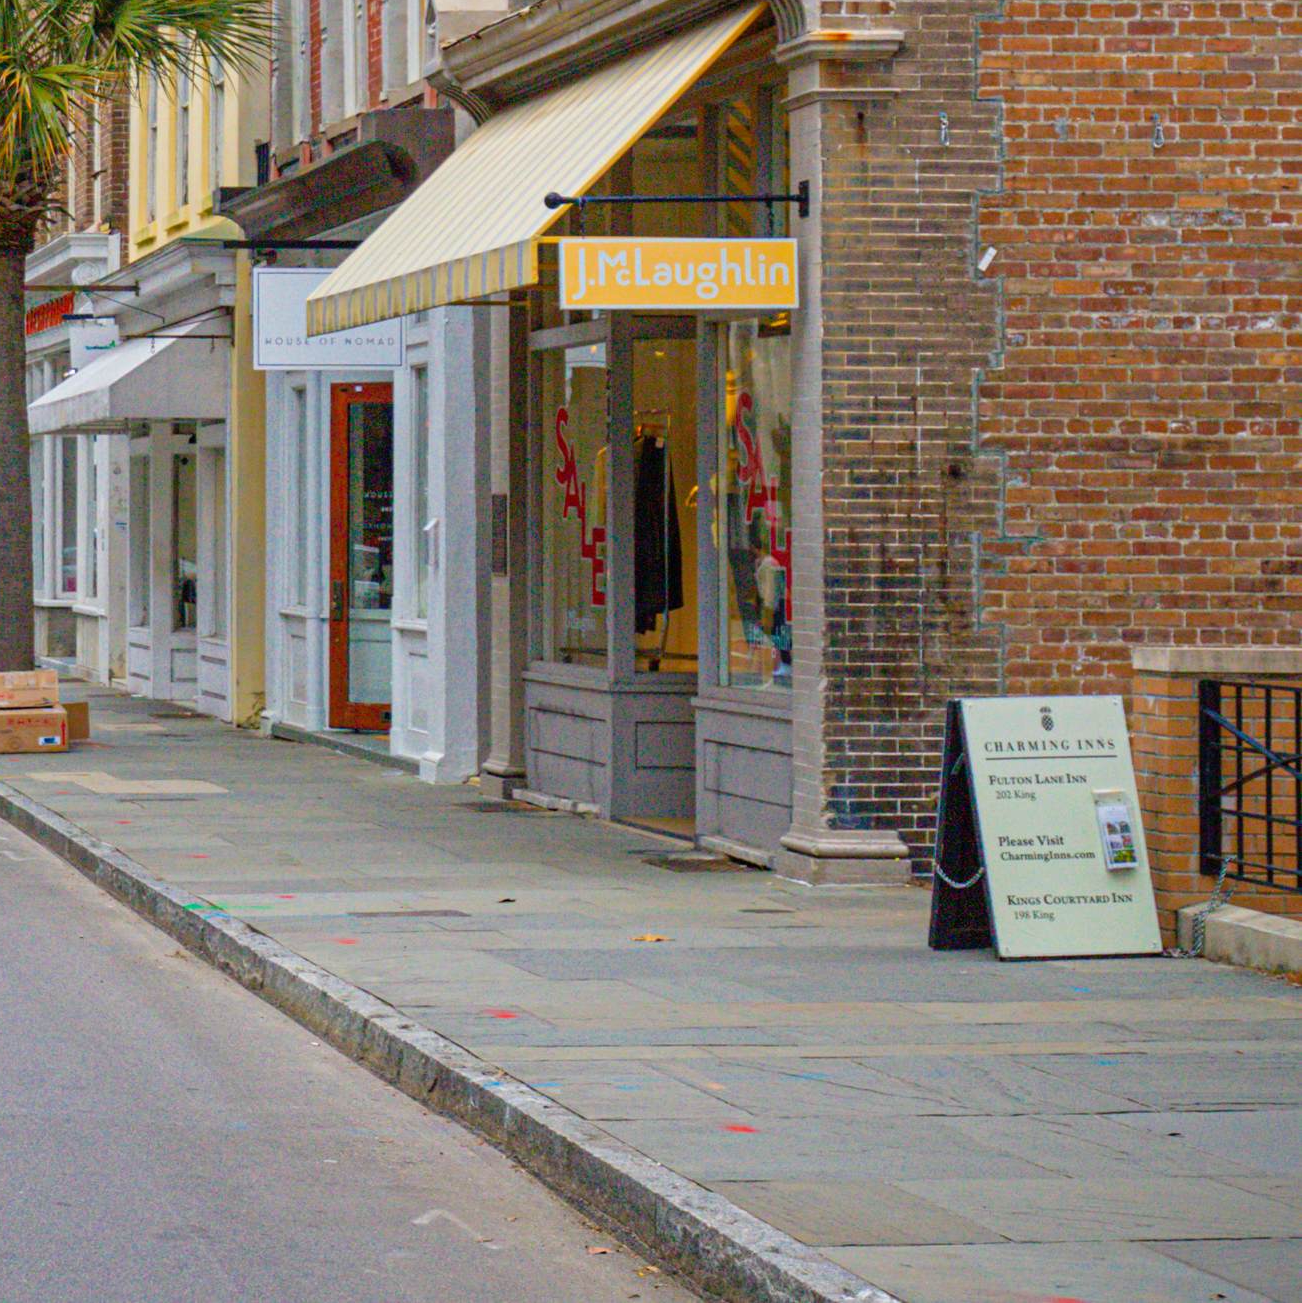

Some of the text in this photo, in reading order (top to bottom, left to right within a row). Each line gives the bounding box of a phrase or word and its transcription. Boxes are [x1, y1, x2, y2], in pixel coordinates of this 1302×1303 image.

[319, 336, 335, 346] OF
[344, 336, 396, 346] NOMAD
[556, 406, 606, 606] SALE
[984, 738, 1116, 753] CHARMING INNS
[988, 773, 1087, 786] FULTON LANE INN
[1014, 790, 1036, 801] King
[998, 835, 1065, 847] Please Visit
[1000, 850, 1096, 863] CharmingInns.com
[1007, 892, 1133, 906] KINGS COURTYARD INN
[1014, 910, 1055, 921] 198 King
